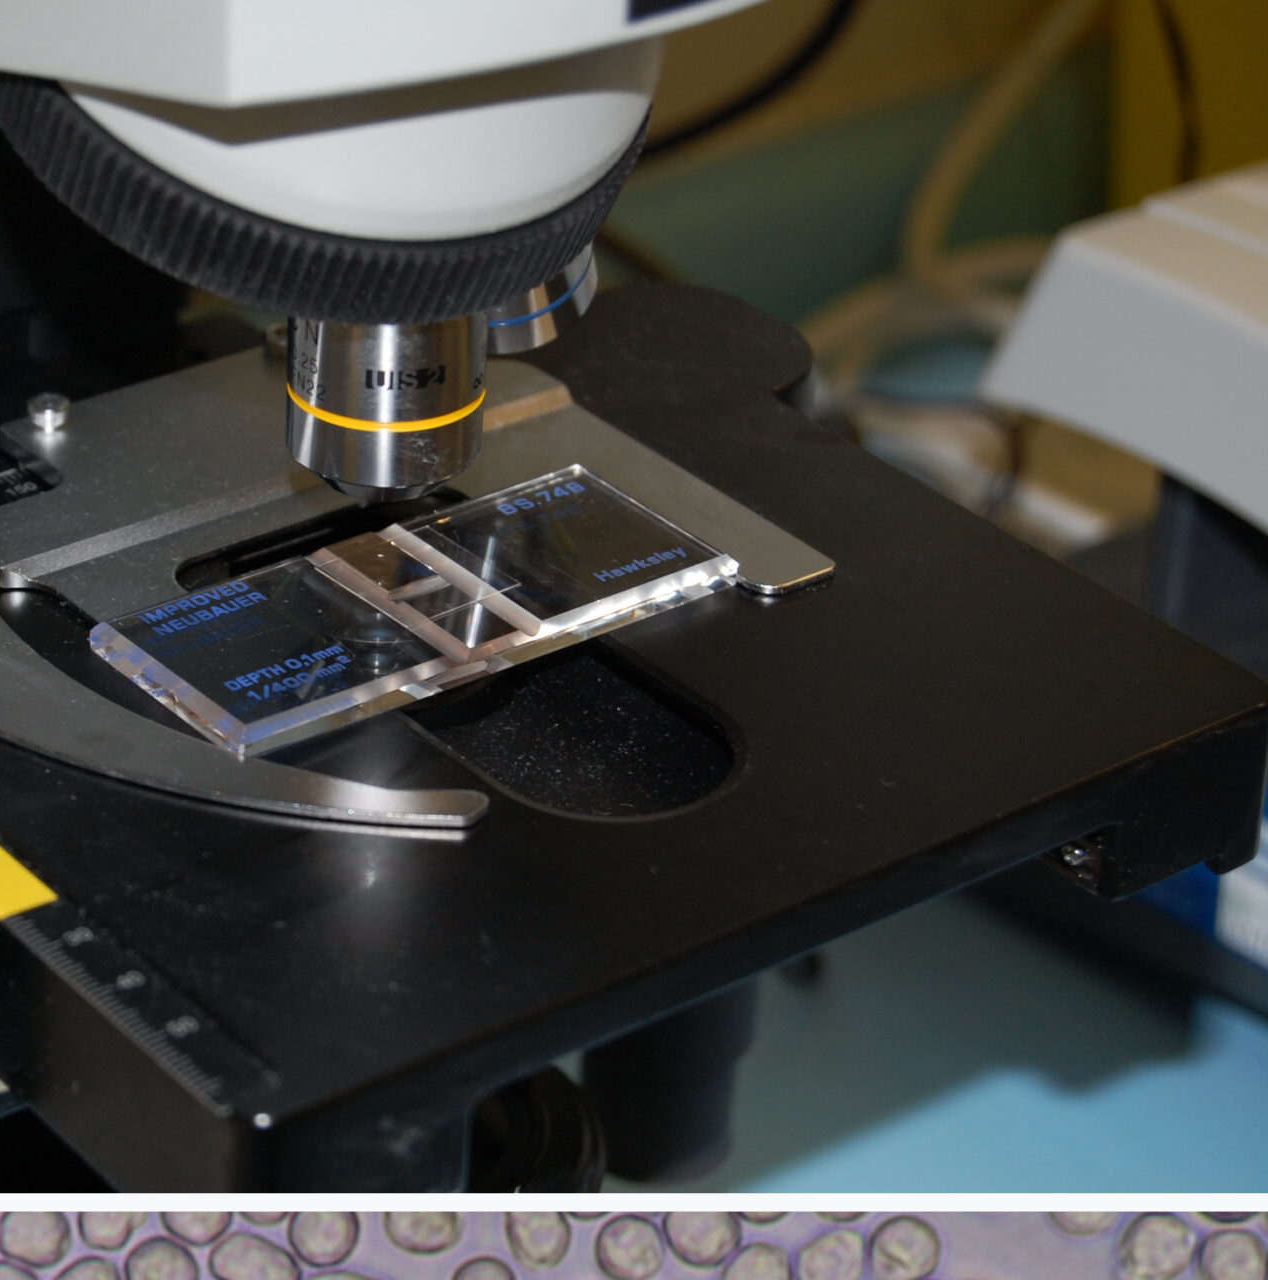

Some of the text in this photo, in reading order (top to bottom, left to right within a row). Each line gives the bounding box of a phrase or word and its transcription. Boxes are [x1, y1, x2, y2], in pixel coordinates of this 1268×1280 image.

[593, 546, 688, 582] Hawksley
[139, 580, 250, 625] IMPROVED
[151, 591, 268, 637] NEUBAUER
[223, 663, 286, 693] DEPTH
[247, 672, 315, 702] 1/400
